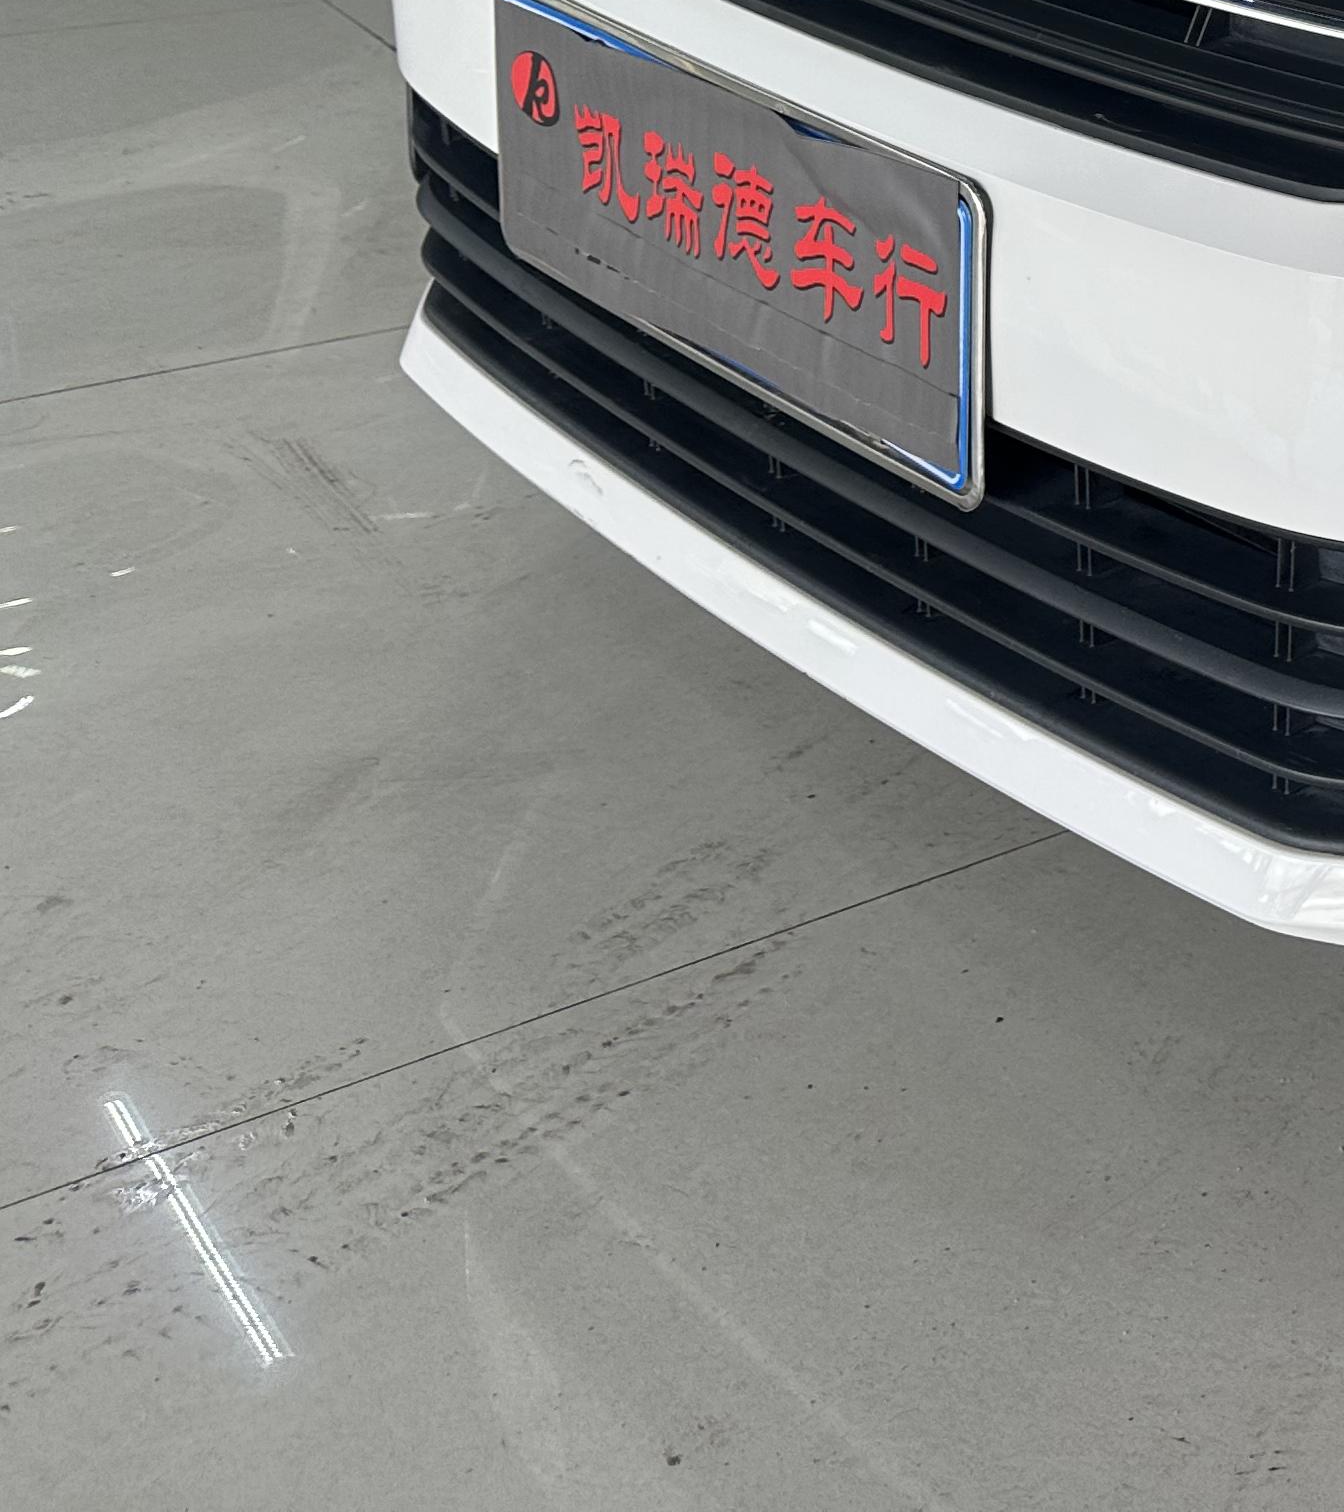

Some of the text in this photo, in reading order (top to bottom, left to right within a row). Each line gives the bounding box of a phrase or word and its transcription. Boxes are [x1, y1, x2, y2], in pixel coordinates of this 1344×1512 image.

[573, 102, 947, 368] 凯瑞德车行
